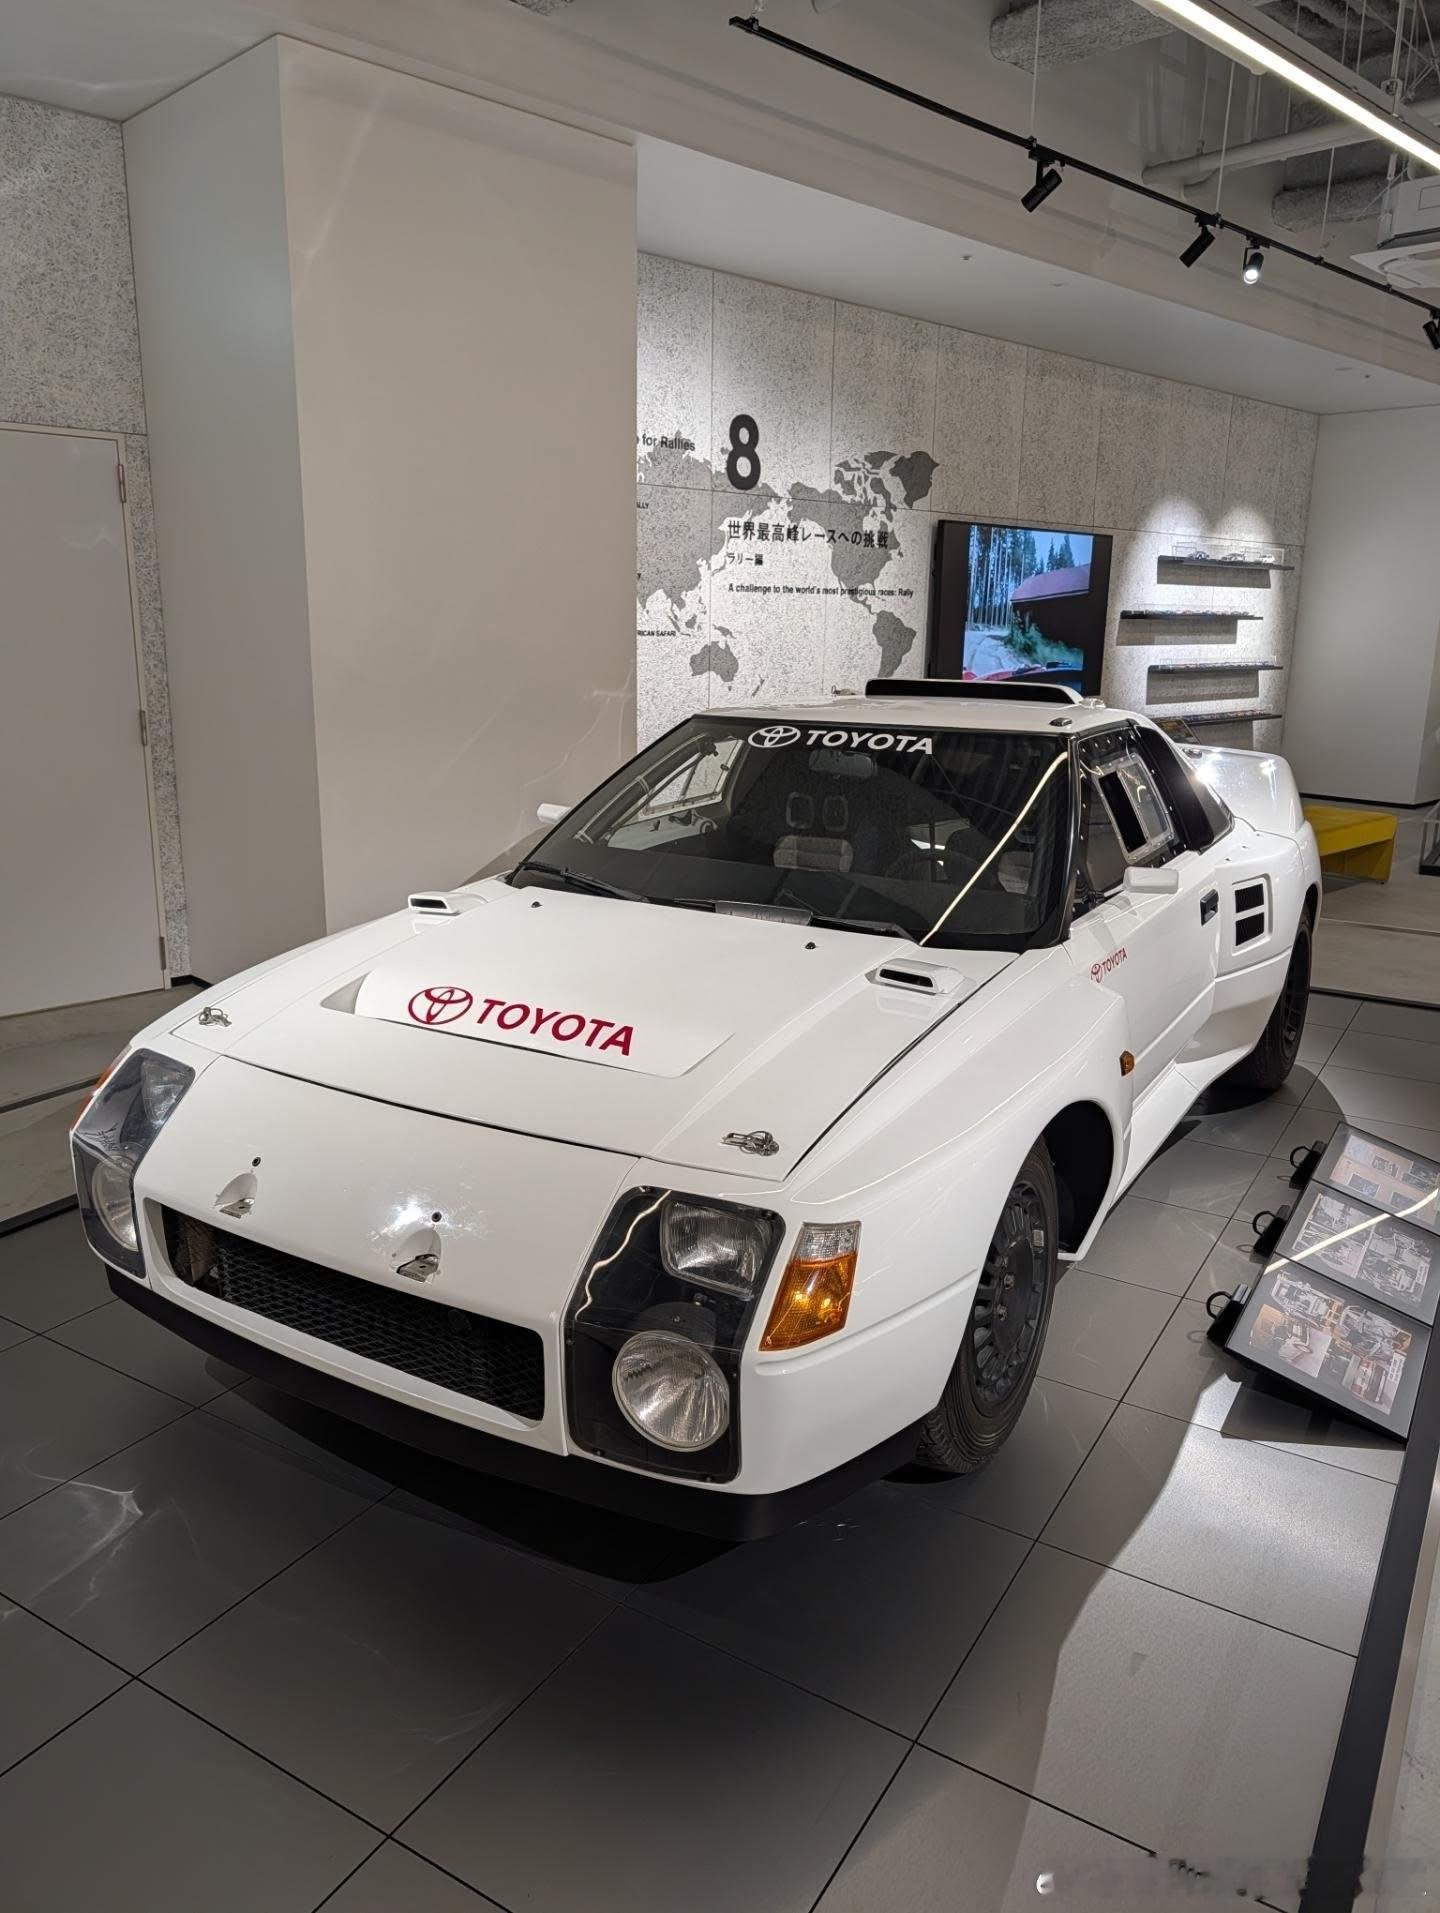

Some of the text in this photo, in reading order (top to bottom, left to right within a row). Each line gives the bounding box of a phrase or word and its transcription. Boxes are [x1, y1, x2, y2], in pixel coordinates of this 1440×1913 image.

[642, 433, 696, 452] for Rallies
[727, 414, 761, 490] 8
[728, 520, 889, 549] 世界最高峰レースへの挑戦
[728, 583, 734, 592] A
[736, 583, 771, 595] challenge
[773, 585, 781, 593] to
[783, 585, 794, 594] the
[795, 586, 820, 594] world's
[822, 587, 839, 595] most
[898, 588, 914, 598] Rally
[806, 730, 933, 754] TOYOTA
[1102, 947, 1127, 974] TOYOTA
[476, 999, 634, 1056] TOYOTA
